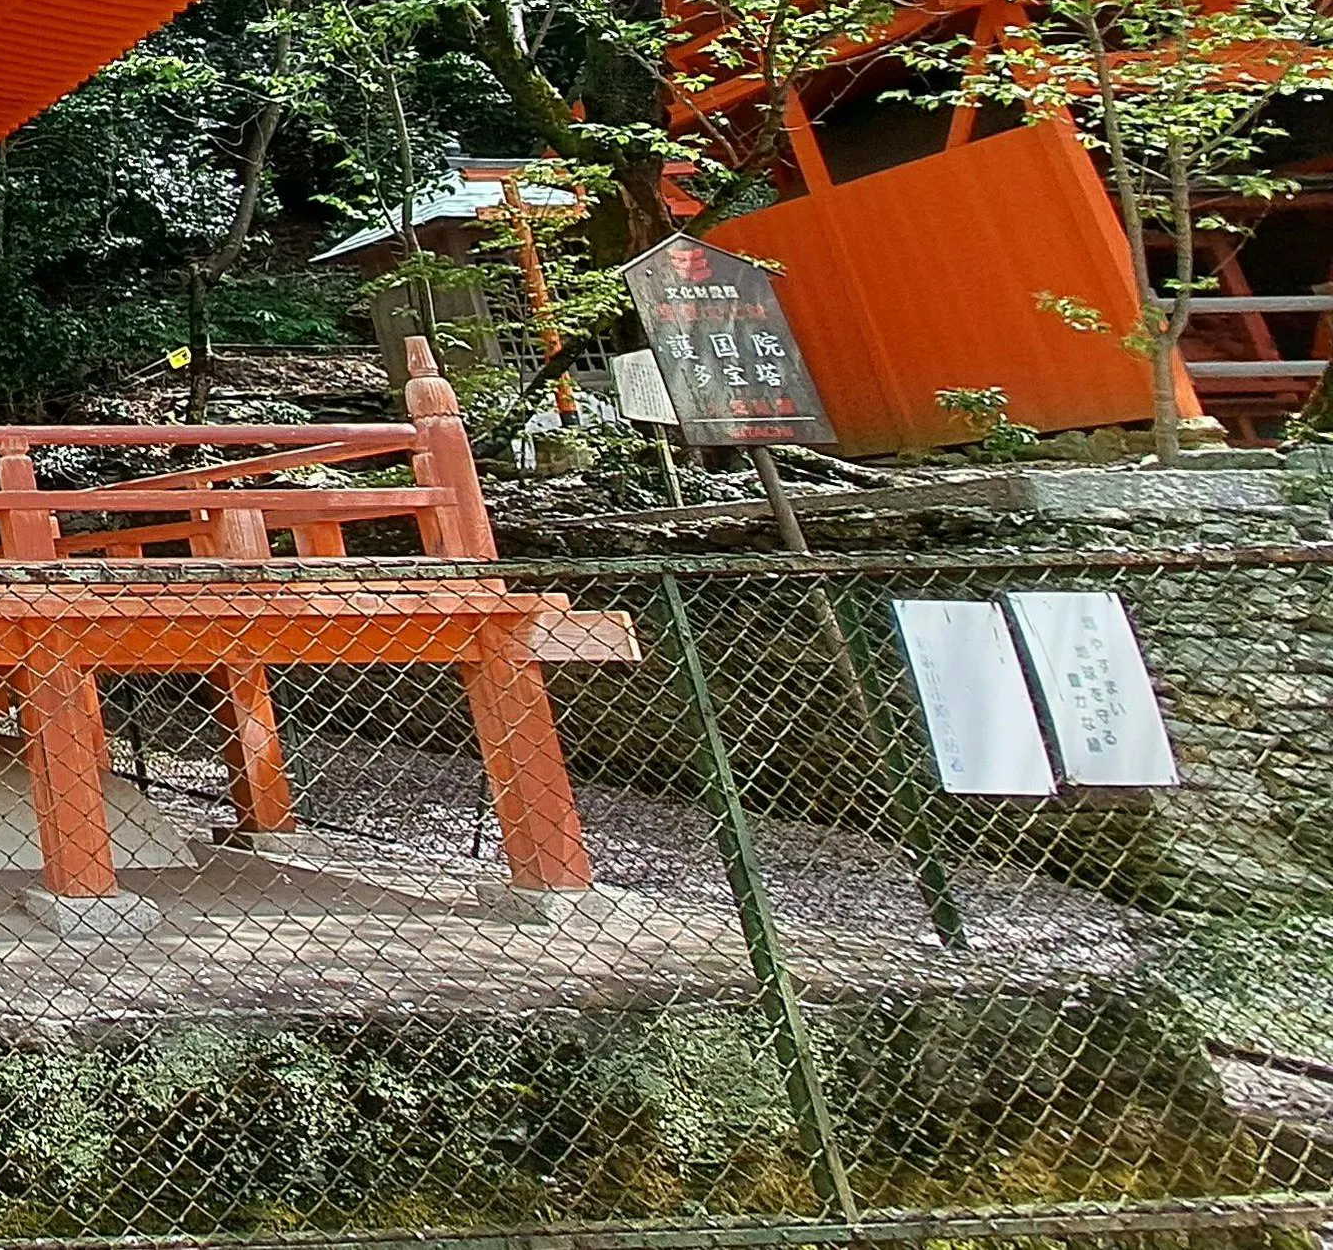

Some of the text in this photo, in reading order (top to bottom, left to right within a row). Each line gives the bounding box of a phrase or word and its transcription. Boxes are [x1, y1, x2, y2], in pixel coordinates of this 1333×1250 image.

[666, 332, 785, 359] 護国院
[693, 362, 782, 388] 多宝塔
